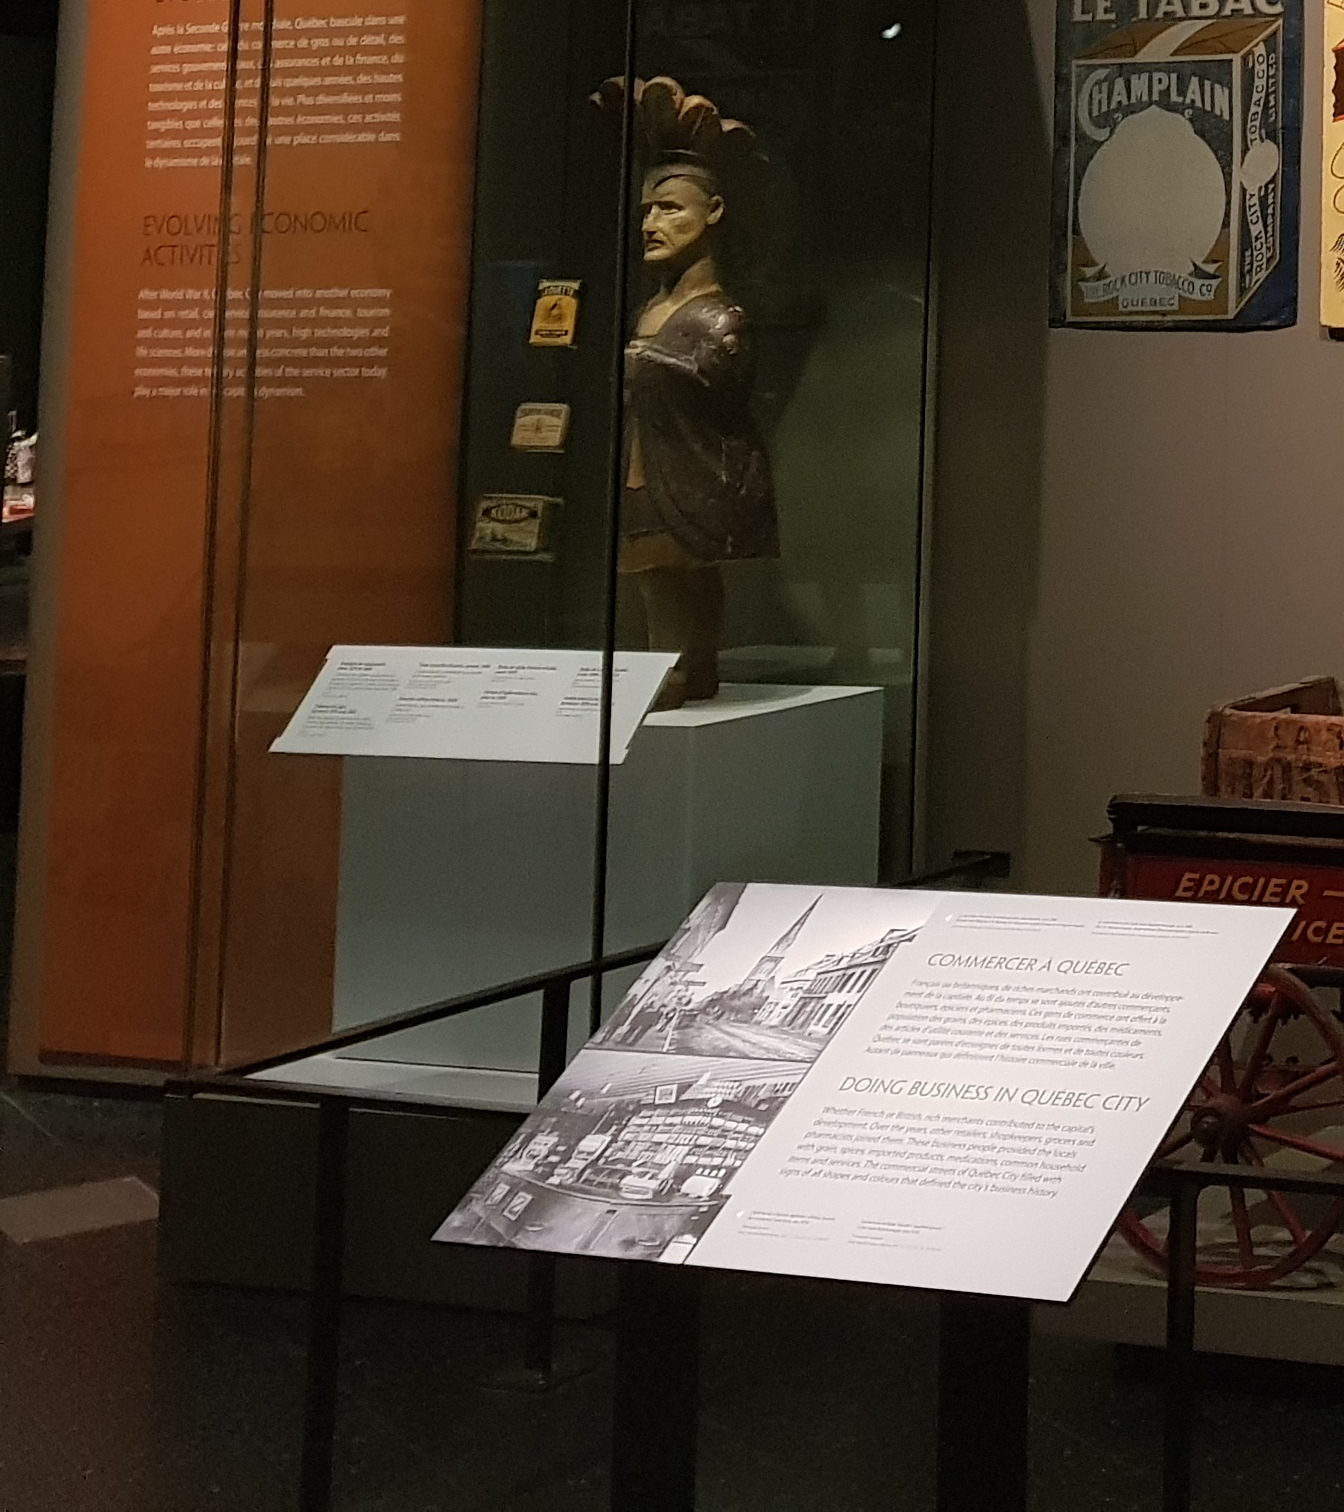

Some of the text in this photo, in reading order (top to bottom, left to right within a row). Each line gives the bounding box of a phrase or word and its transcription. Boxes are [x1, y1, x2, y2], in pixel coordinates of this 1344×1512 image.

[1078, 69, 1231, 141] CHAMPLAIN
[1248, 52, 1266, 146] TOBACCO
[250, 210, 369, 235] CONOMIC
[1128, 271, 1151, 286] CITY
[1174, 871, 1310, 906] EPICIER
[926, 952, 1038, 973] COMMERCER
[1056, 958, 1131, 977] QUÉBEC
[838, 1075, 908, 1095] DOING
[907, 1080, 993, 1102] BUSINESS
[994, 1086, 1017, 1103] IN
[1100, 1093, 1152, 1115] CITY
